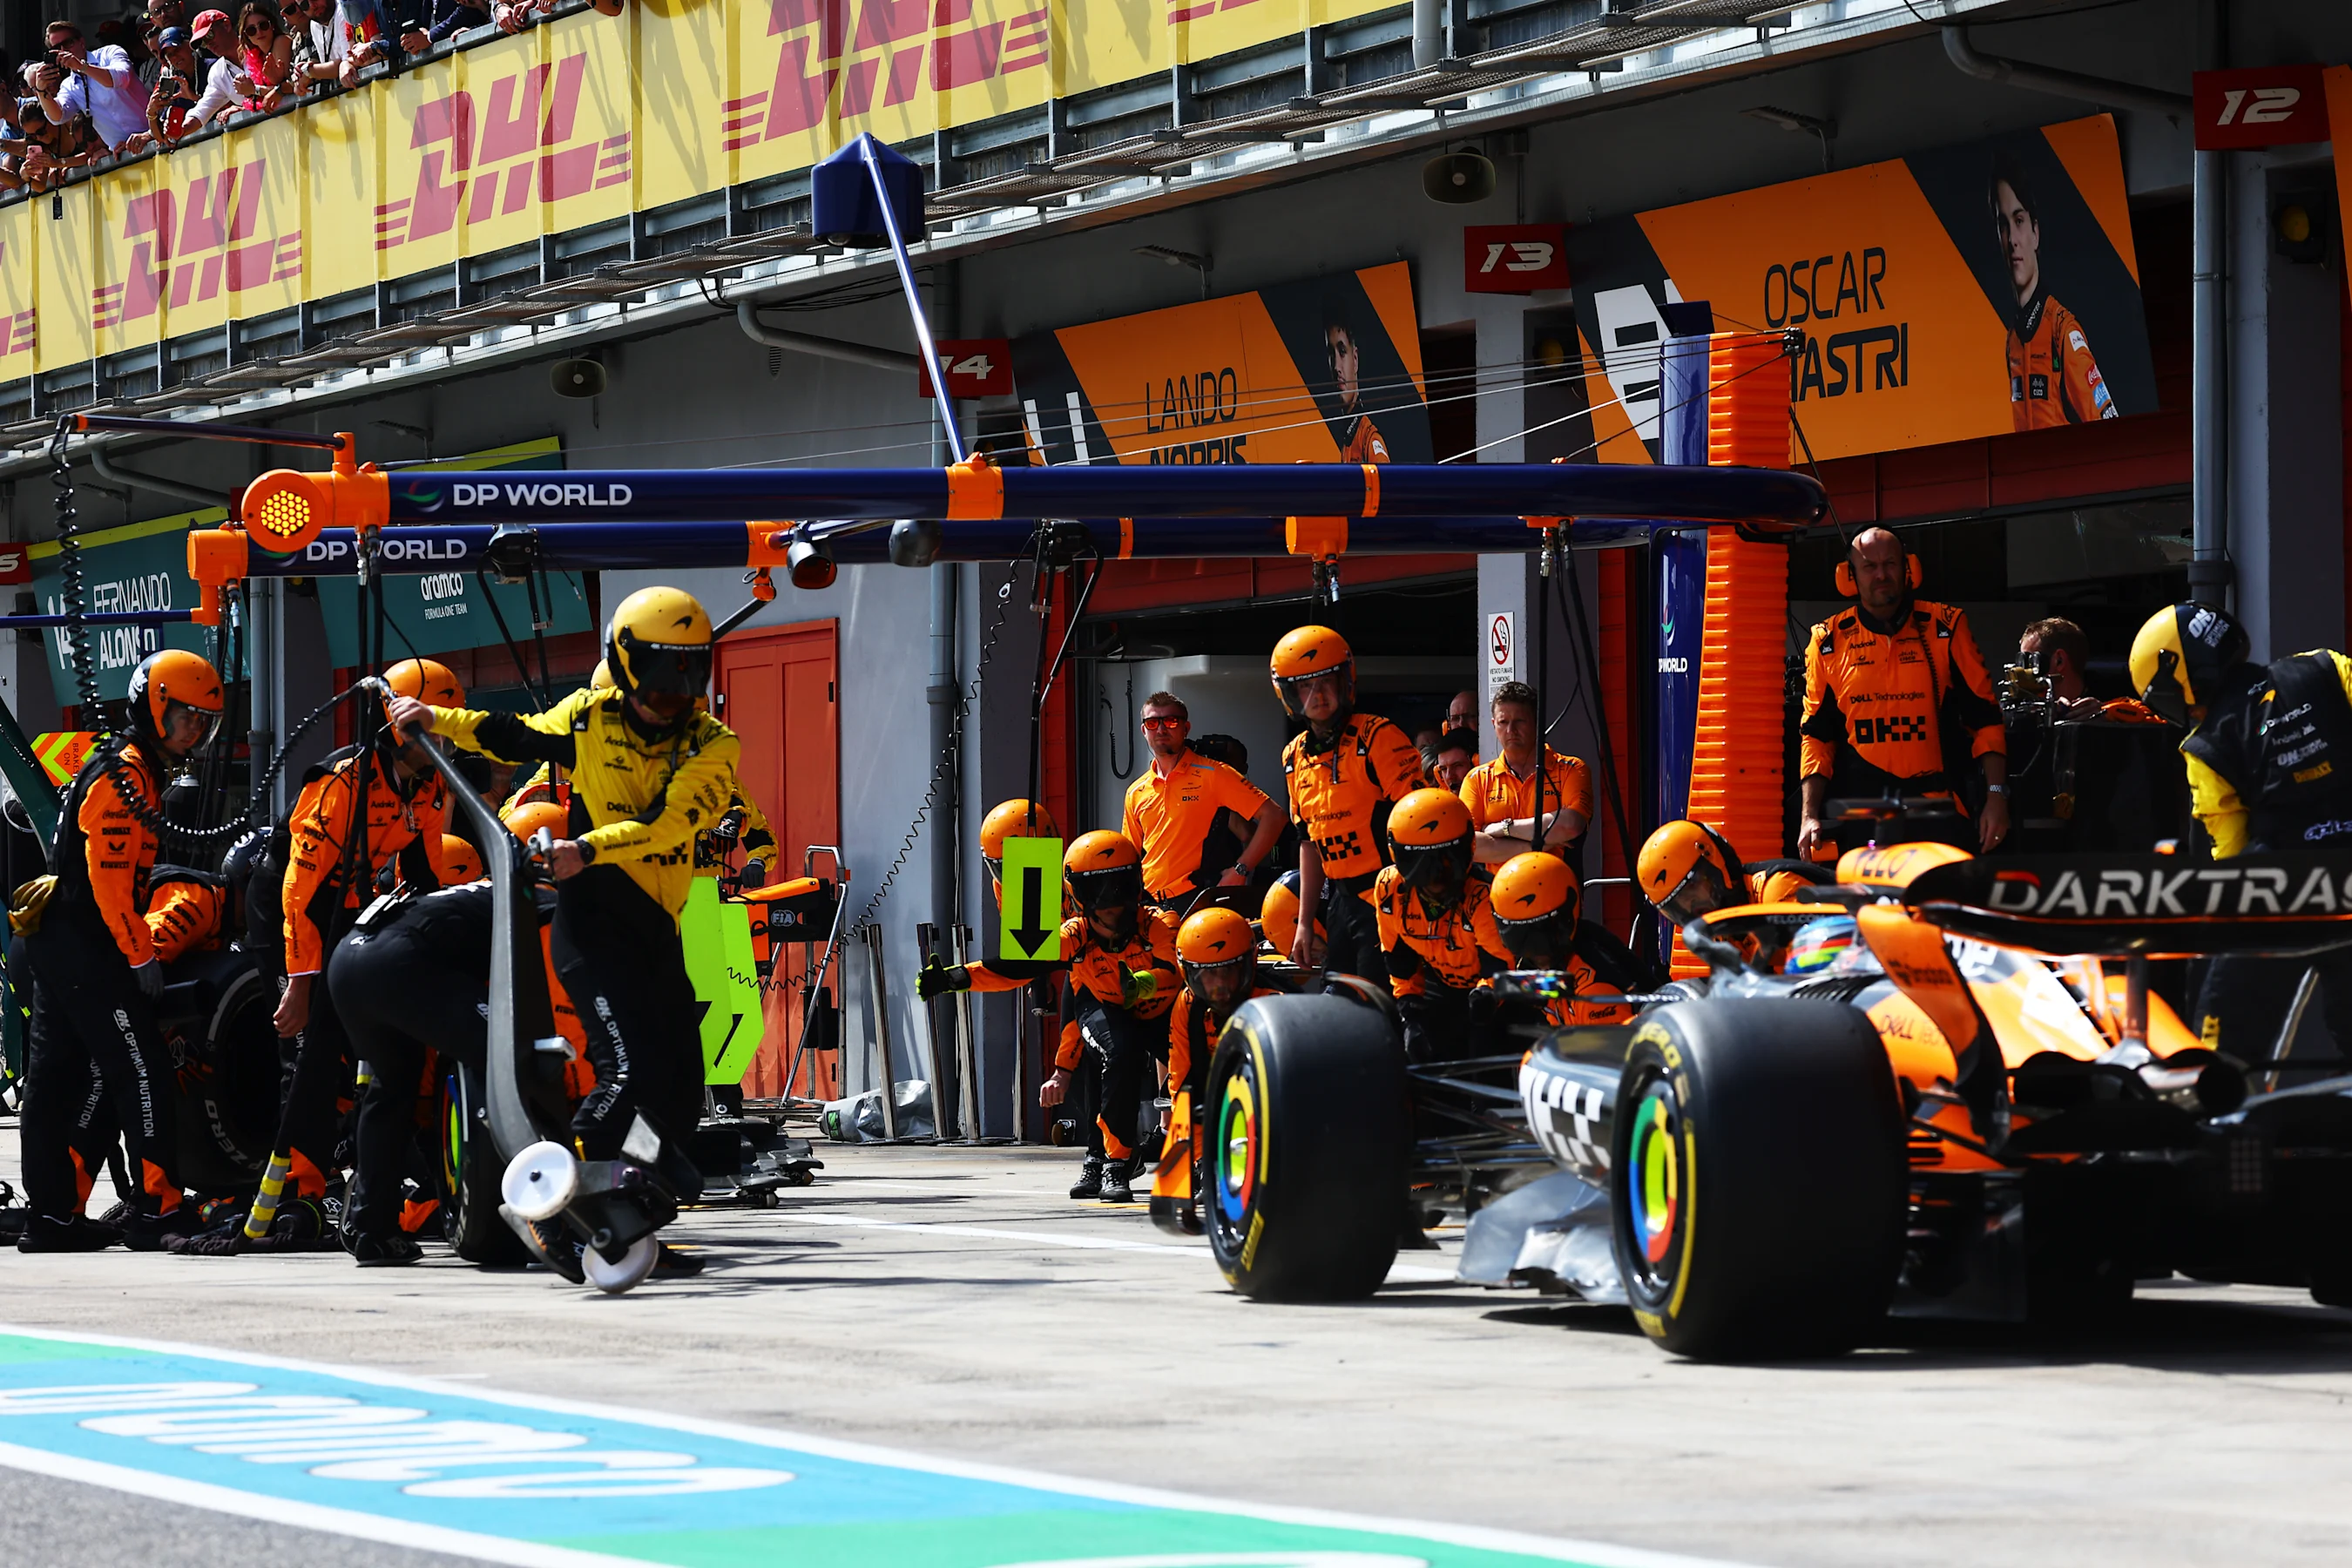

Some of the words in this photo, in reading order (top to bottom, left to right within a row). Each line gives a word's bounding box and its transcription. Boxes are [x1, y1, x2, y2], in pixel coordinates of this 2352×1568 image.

[2216, 87, 2301, 125] 12
[409, 52, 598, 242] DHL
[123, 159, 267, 321] DHL
[1480, 242, 1554, 273] 13
[1764, 247, 1886, 328] OSCAR
[1791, 322, 1908, 402] IASTRI
[1146, 367, 1237, 434] LANDO
[453, 483, 499, 506] DP
[504, 483, 633, 506] WORLD
[307, 541, 348, 561] DP
[93, 571, 172, 614] FERNANDO
[420, 572, 463, 602] aramco
[1849, 639, 1876, 650] Android
[1850, 694, 1872, 704] DELL
[1875, 692, 1925, 702] Technologies
[1855, 716, 1926, 745] OKX
[64, 753, 71, 766] ON
[607, 801, 635, 814] DELL
[1988, 869, 2352, 916] DARKTRA
[124, 1031, 148, 1078] OPTIMUM
[139, 1079, 154, 1138] NUTRITION
[203, 1098, 249, 1166] ZERO
